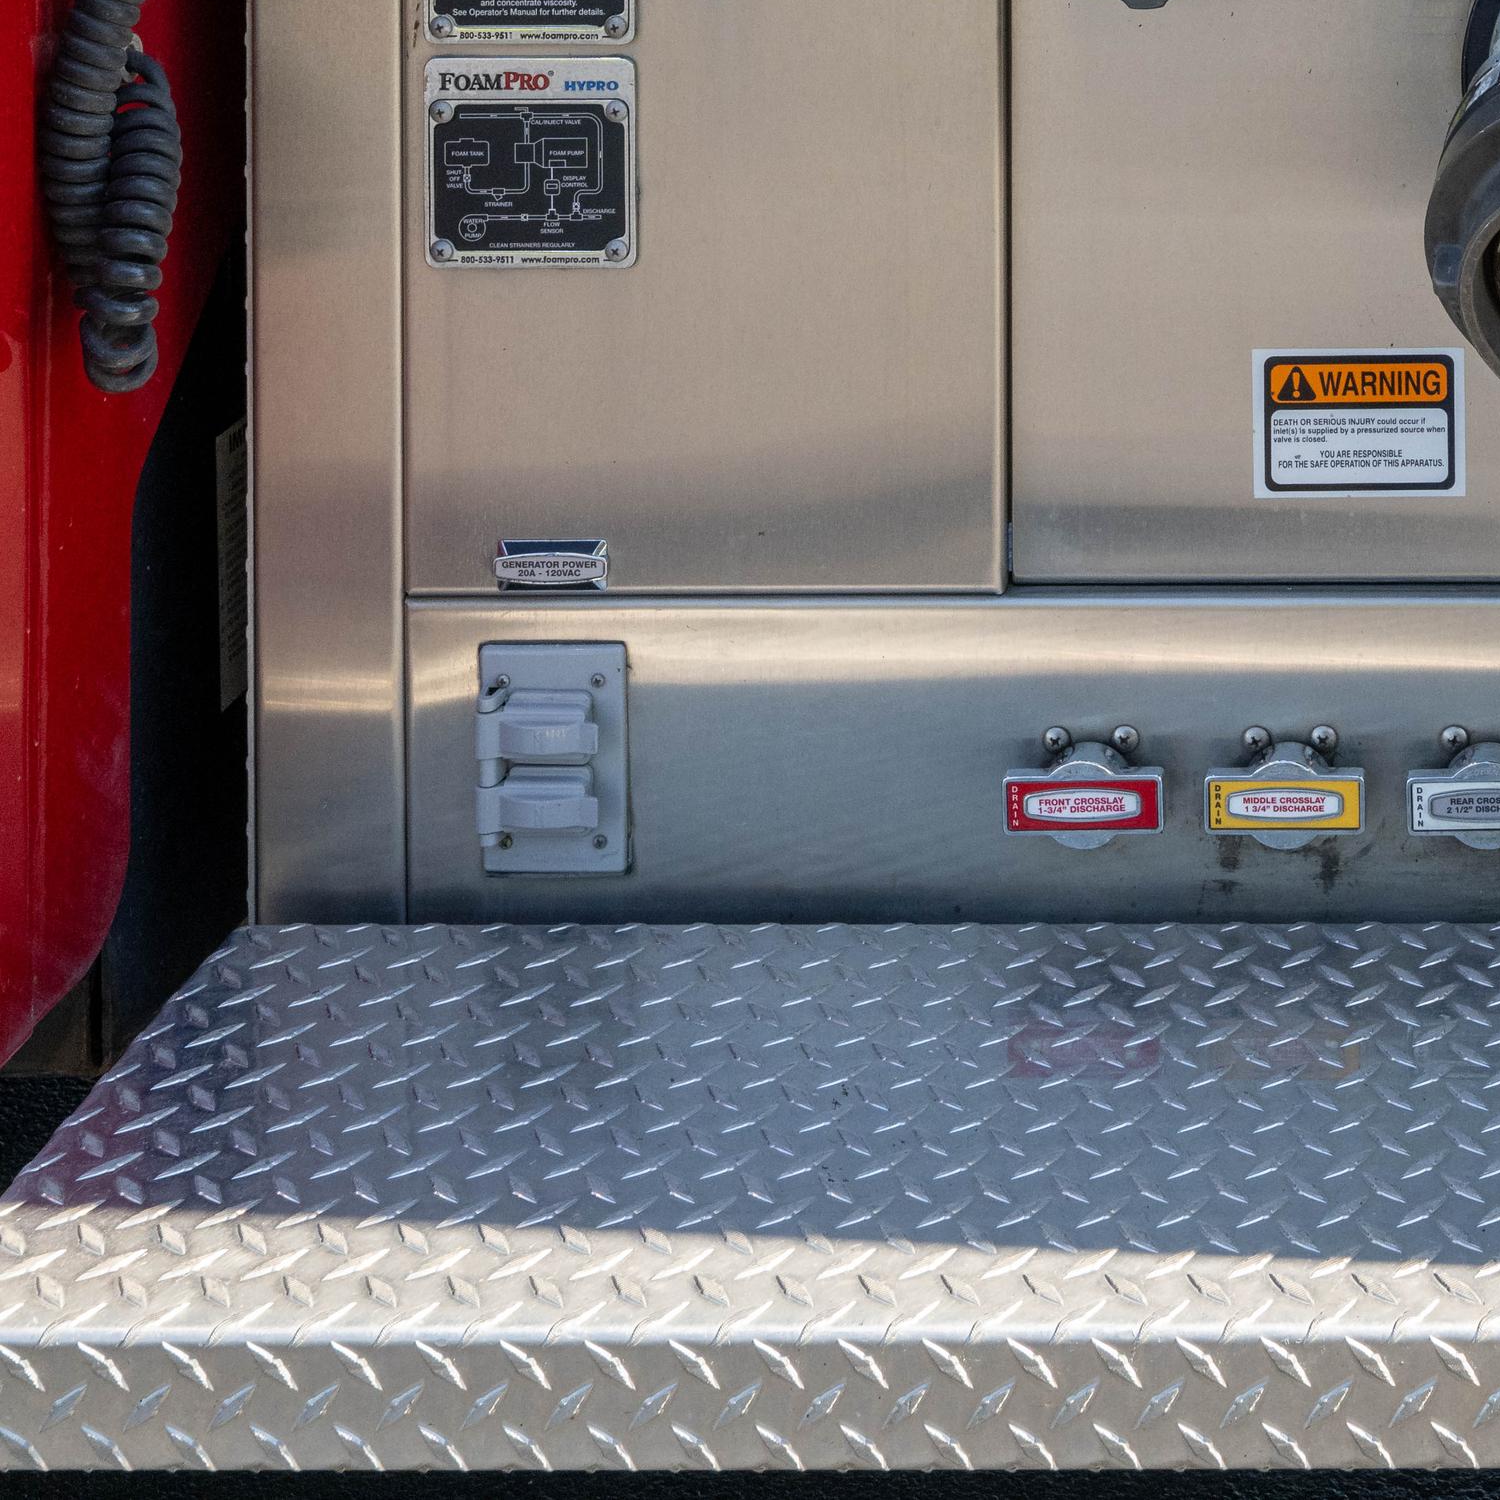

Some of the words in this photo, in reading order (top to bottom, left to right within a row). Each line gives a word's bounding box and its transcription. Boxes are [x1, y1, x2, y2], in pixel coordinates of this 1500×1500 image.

[565, 81, 618, 91] HYPRO
[461, 255, 514, 263] 800-533-9511
[521, 256, 599, 264] www.foampro.com
[1320, 370, 1440, 396] WARNING
[502, 561, 559, 569] GENERATOR
[562, 560, 597, 568] POWER
[518, 569, 536, 577] 20A
[546, 569, 581, 577] 120VAC
[1039, 798, 1072, 807] FRONT
[1075, 796, 1124, 806] CROSSLAY
[1038, 805, 1067, 814] 1-3/4"
[1070, 804, 1125, 813] DISCHARGE
